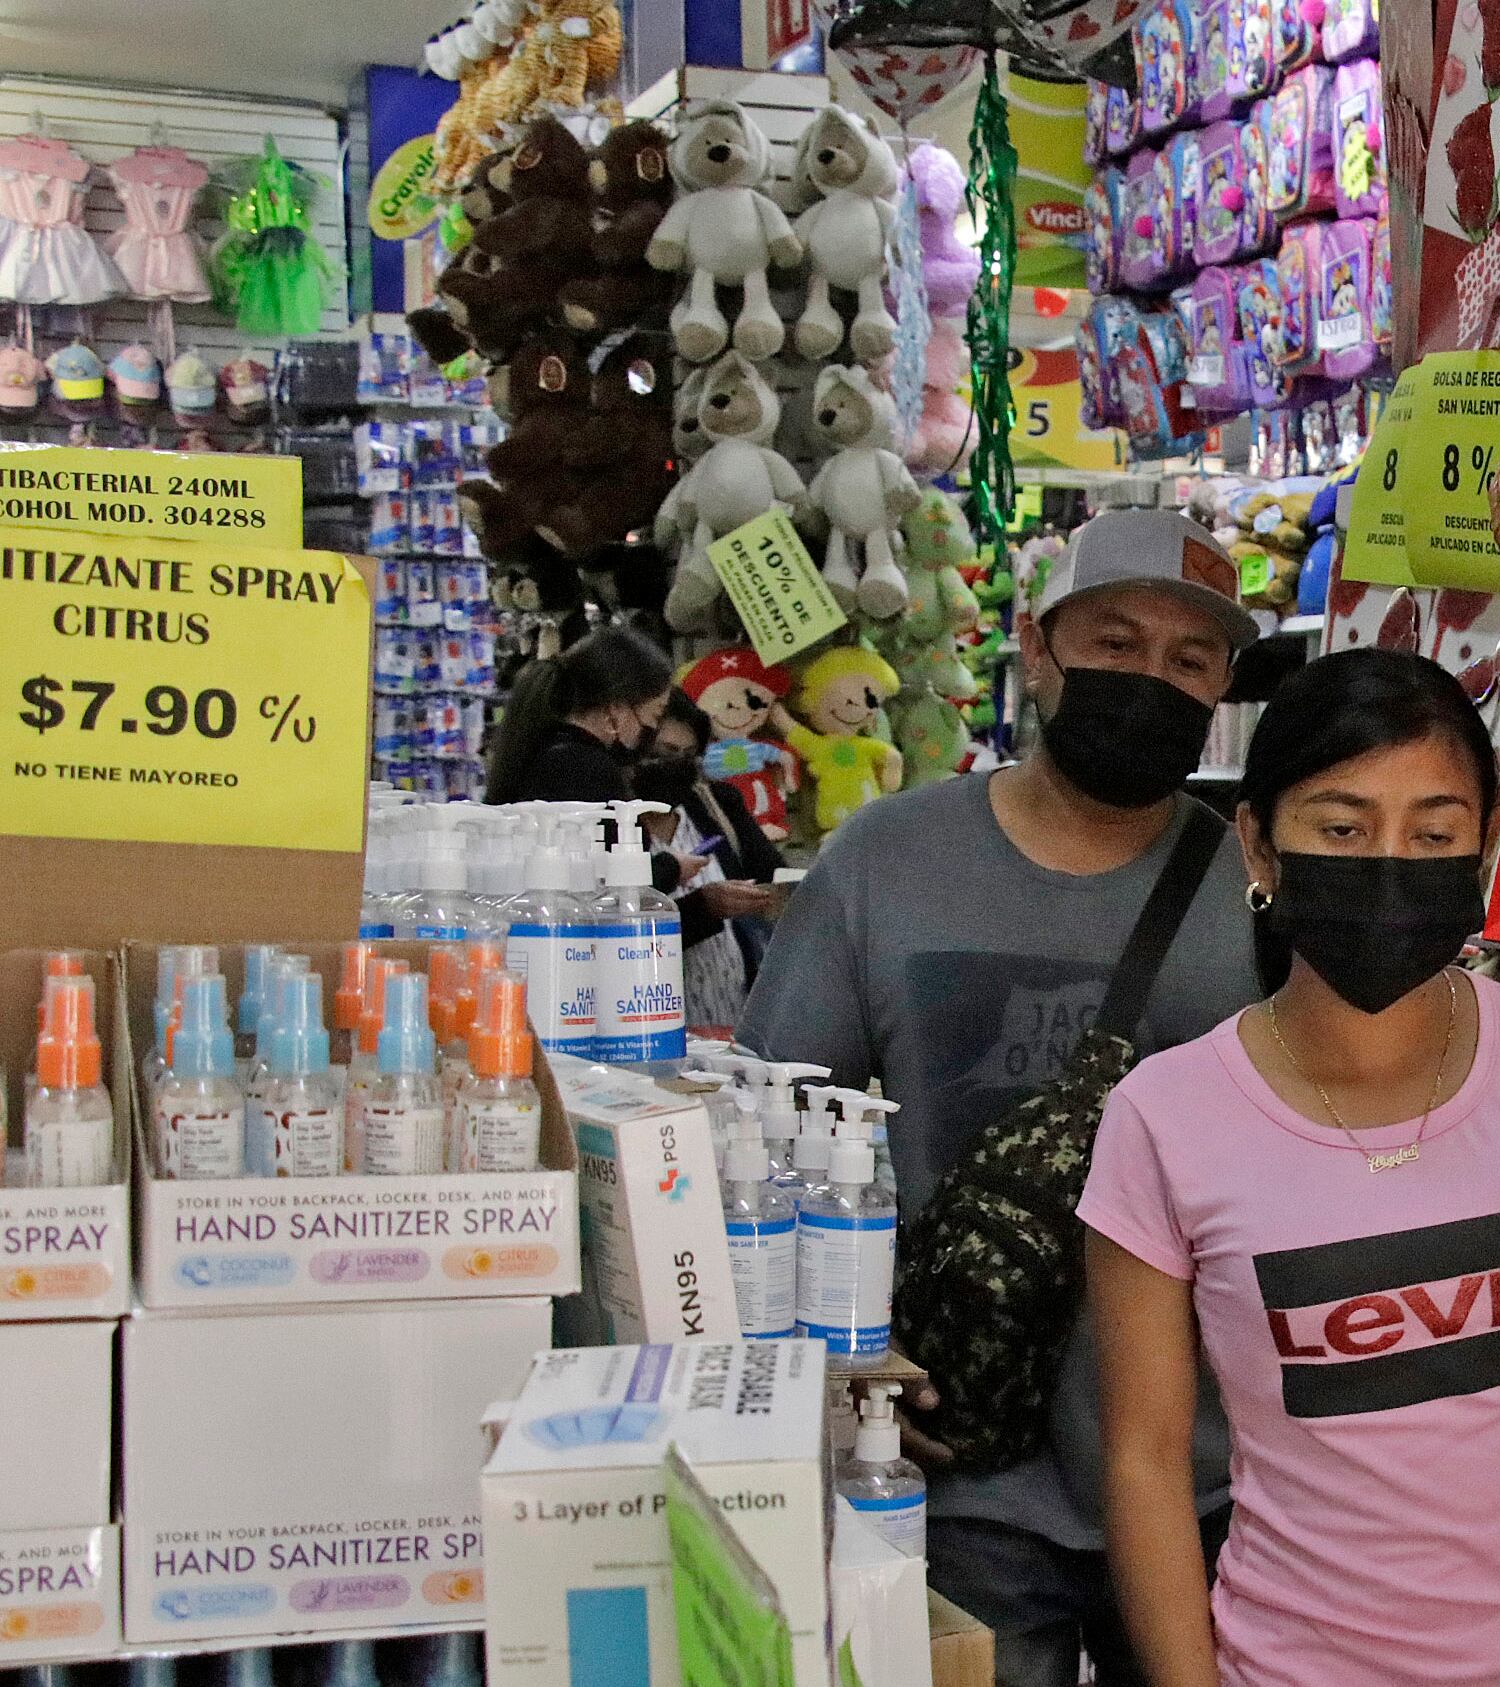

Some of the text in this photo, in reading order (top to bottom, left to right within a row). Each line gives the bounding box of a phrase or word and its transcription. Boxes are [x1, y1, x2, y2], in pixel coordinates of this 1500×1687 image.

[1030, 207, 1084, 230] Vinci
[1433, 371, 1462, 387] BOLSA
[1465, 371, 1479, 387] DE
[1027, 402, 1049, 436] 5
[1438, 398, 1457, 414] SAN
[1383, 448, 1399, 491] 8
[168, 476, 256, 499] 240ML
[88, 502, 155, 524] MOD.
[164, 506, 267, 529] 304288
[1430, 536, 1469, 552] APLICADO
[1472, 540, 1483, 553] EN
[2, 547, 343, 605] ITIZANTE SPRAY
[757, 535, 812, 625] 10% DE
[730, 539, 796, 645] DESCUENTO
[53, 603, 210, 645] CITRUS
[19, 674, 238, 739] $7.90
[14, 761, 239, 788] NO TIENE MAYOREO
[616, 996, 683, 1014] SANITIZER
[633, 983, 673, 999] HAND
[560, 1001, 595, 1016] SANIT
[660, 1124, 678, 1163] PCS
[583, 1156, 617, 1186] KN95
[26, 1207, 58, 1218] AND
[65, 1205, 105, 1217] MORE
[177, 1197, 220, 1209] STORE
[228, 1196, 242, 1207] IN
[249, 1195, 287, 1207] YOUR
[483, 1190, 512, 1200] AND
[176, 1206, 557, 1243] HAND SANITIZER SPRAY
[4, 1224, 109, 1254] SPRAY
[674, 1250, 705, 1336] KN95
[514, 1490, 786, 1525] 3 Layer of Pction
[156, 1531, 200, 1544] STORE
[206, 1529, 222, 1541] IN
[228, 1526, 266, 1540] YOUR
[18, 1546, 52, 1559] AND
[155, 1546, 256, 1577] HAND
[269, 1535, 430, 1570] SANITIZER
